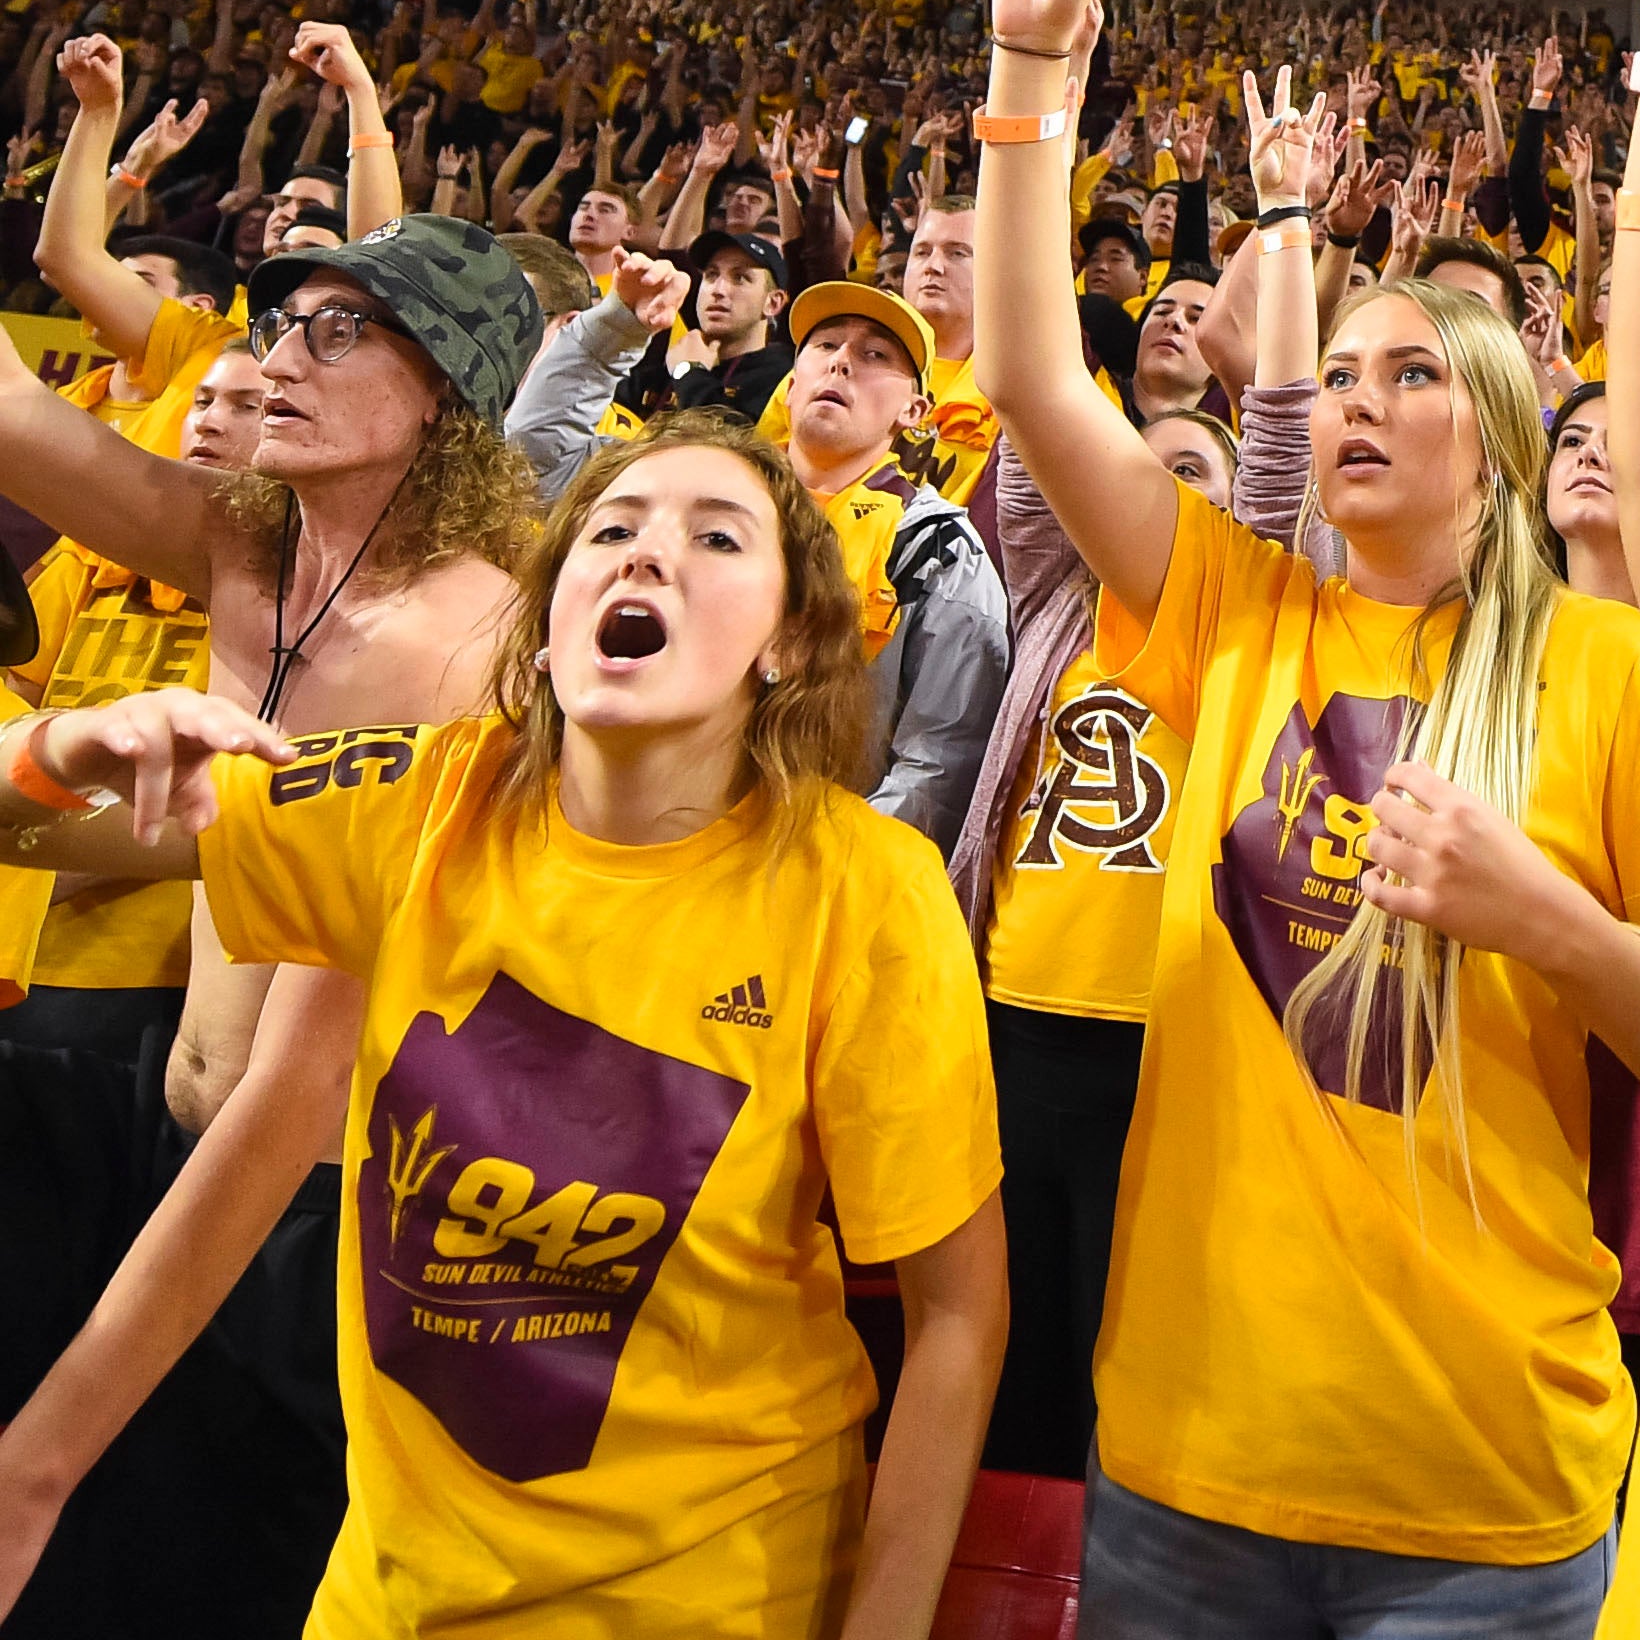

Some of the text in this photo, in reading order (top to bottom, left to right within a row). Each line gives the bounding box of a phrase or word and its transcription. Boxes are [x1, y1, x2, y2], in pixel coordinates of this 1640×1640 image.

[55, 617, 208, 683] THE
[1301, 877, 1366, 907] SUN DEV
[701, 1005, 773, 1029] adidas
[433, 1156, 666, 1270] 942
[422, 1263, 466, 1285] SUN
[467, 1263, 521, 1285] DEVIL
[411, 1306, 482, 1344] TEMPE
[510, 1311, 612, 1344] ARIZONA
